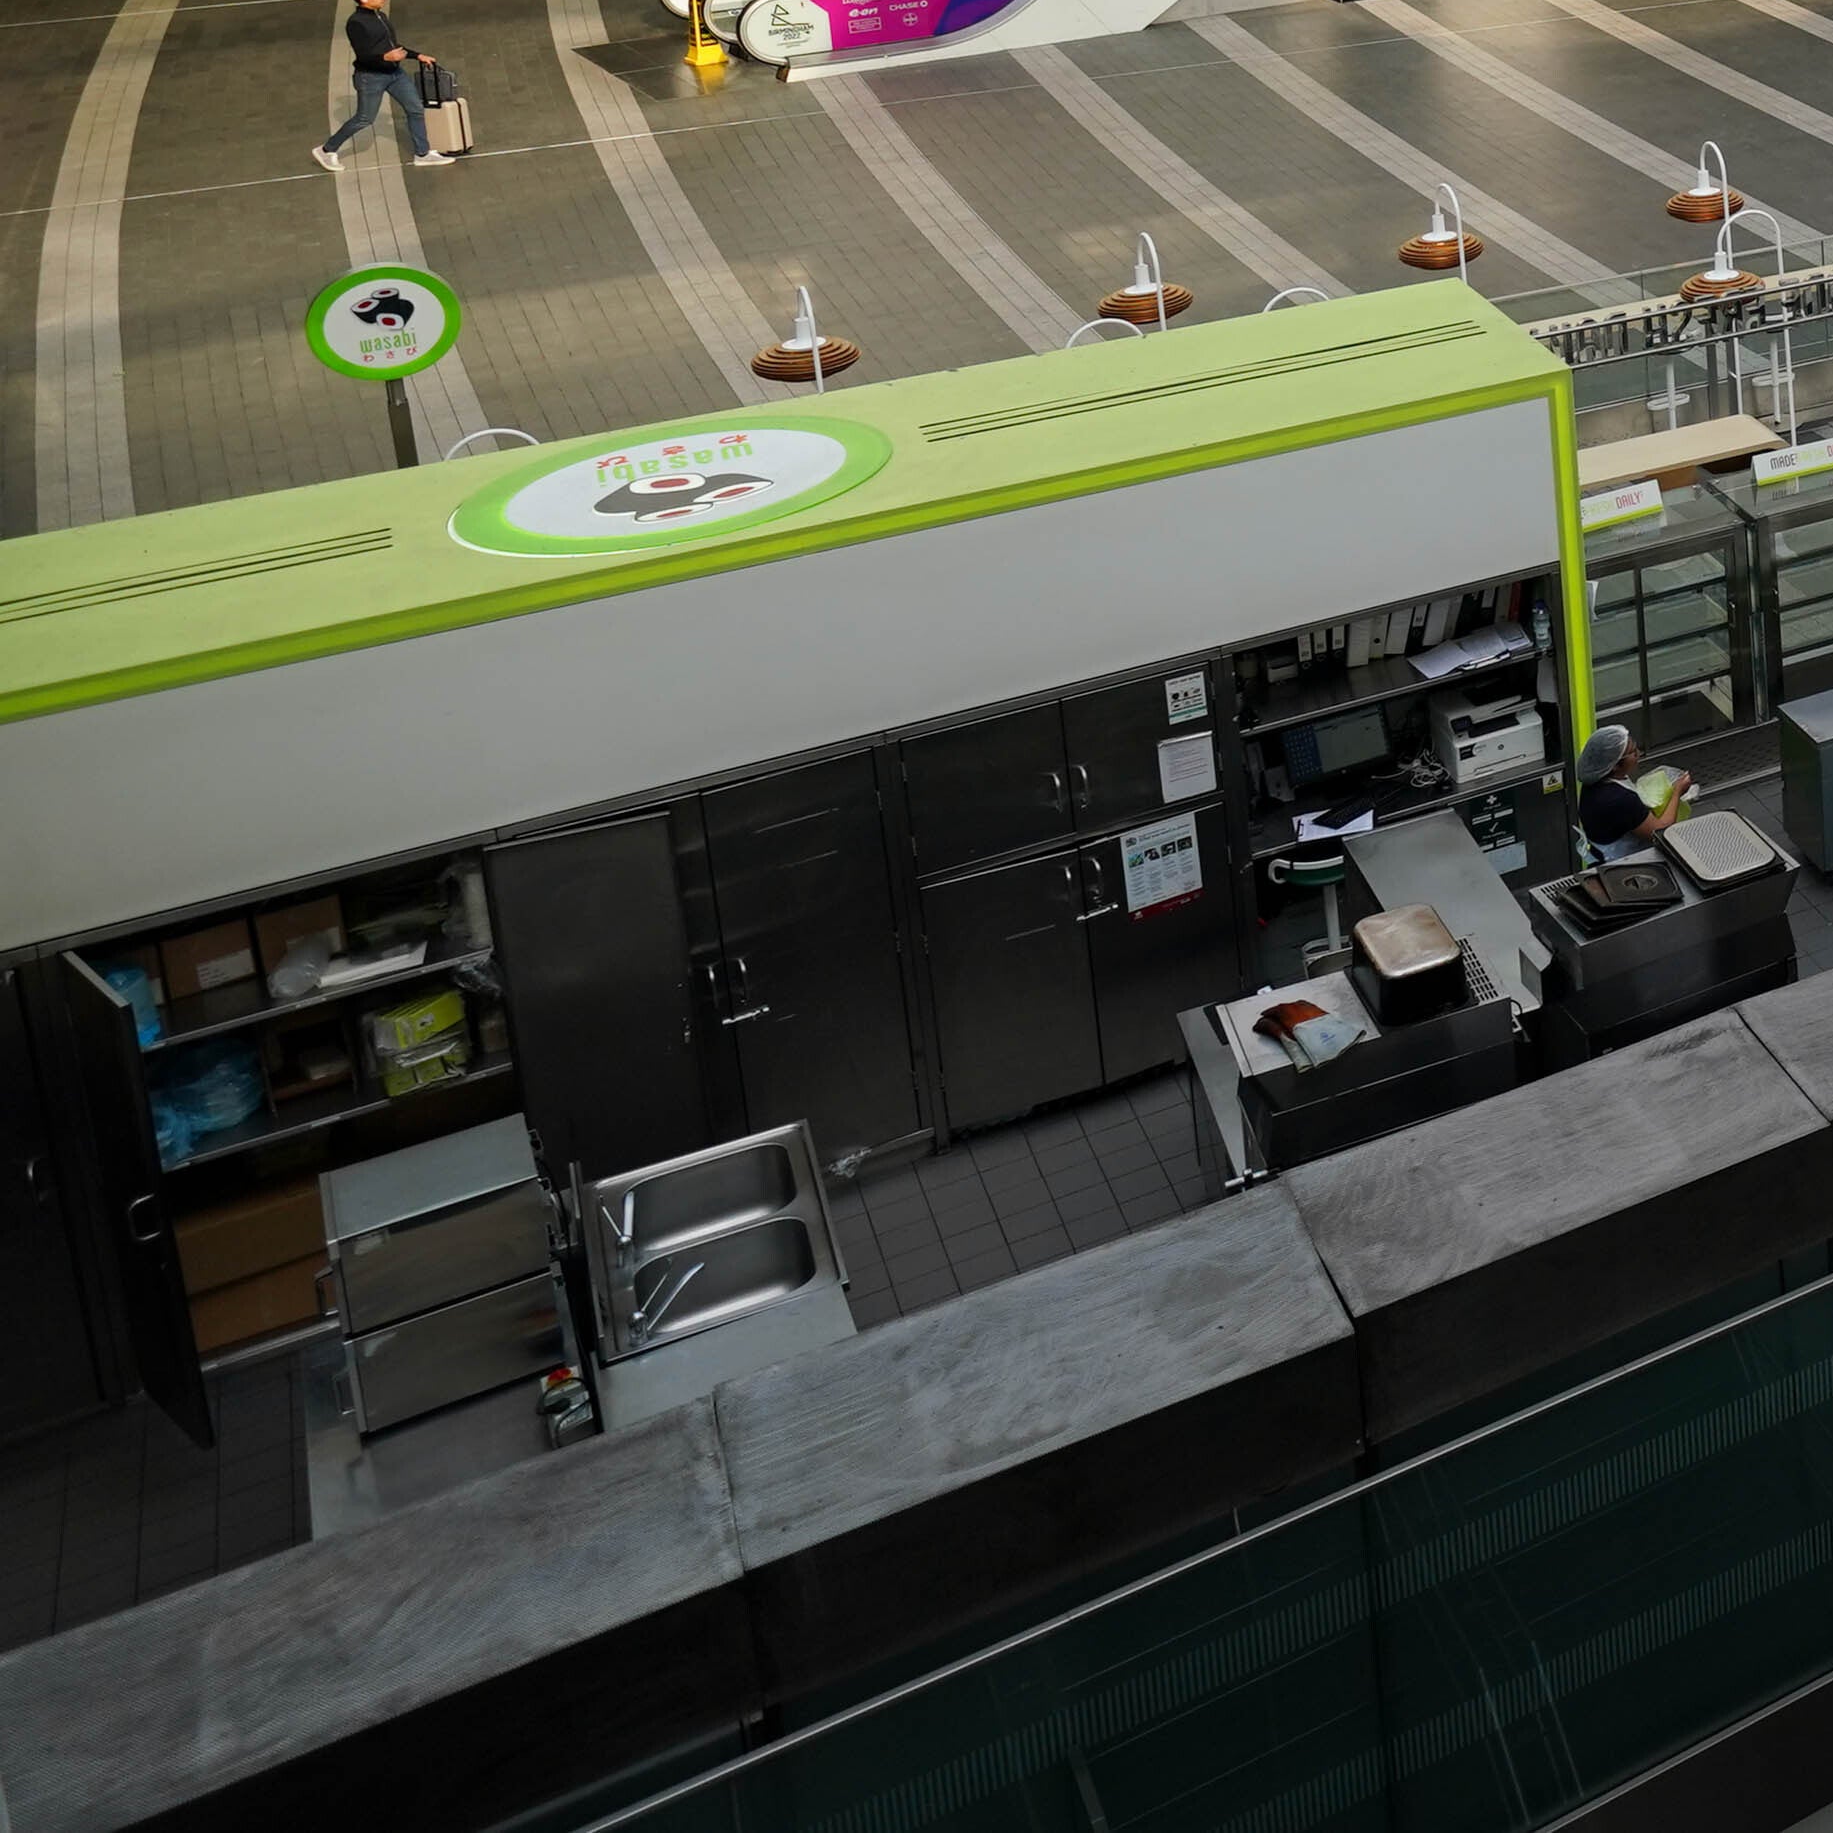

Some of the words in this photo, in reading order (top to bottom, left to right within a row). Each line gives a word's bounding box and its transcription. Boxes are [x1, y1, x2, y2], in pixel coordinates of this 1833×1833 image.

[888, 1, 920, 12] CHASE
[767, 23, 815, 36] BIRMINGHAM
[782, 32, 801, 41] 2022
[359, 326, 417, 354] wasabi
[595, 442, 754, 488] wasabi
[1769, 452, 1796, 470] MADE
